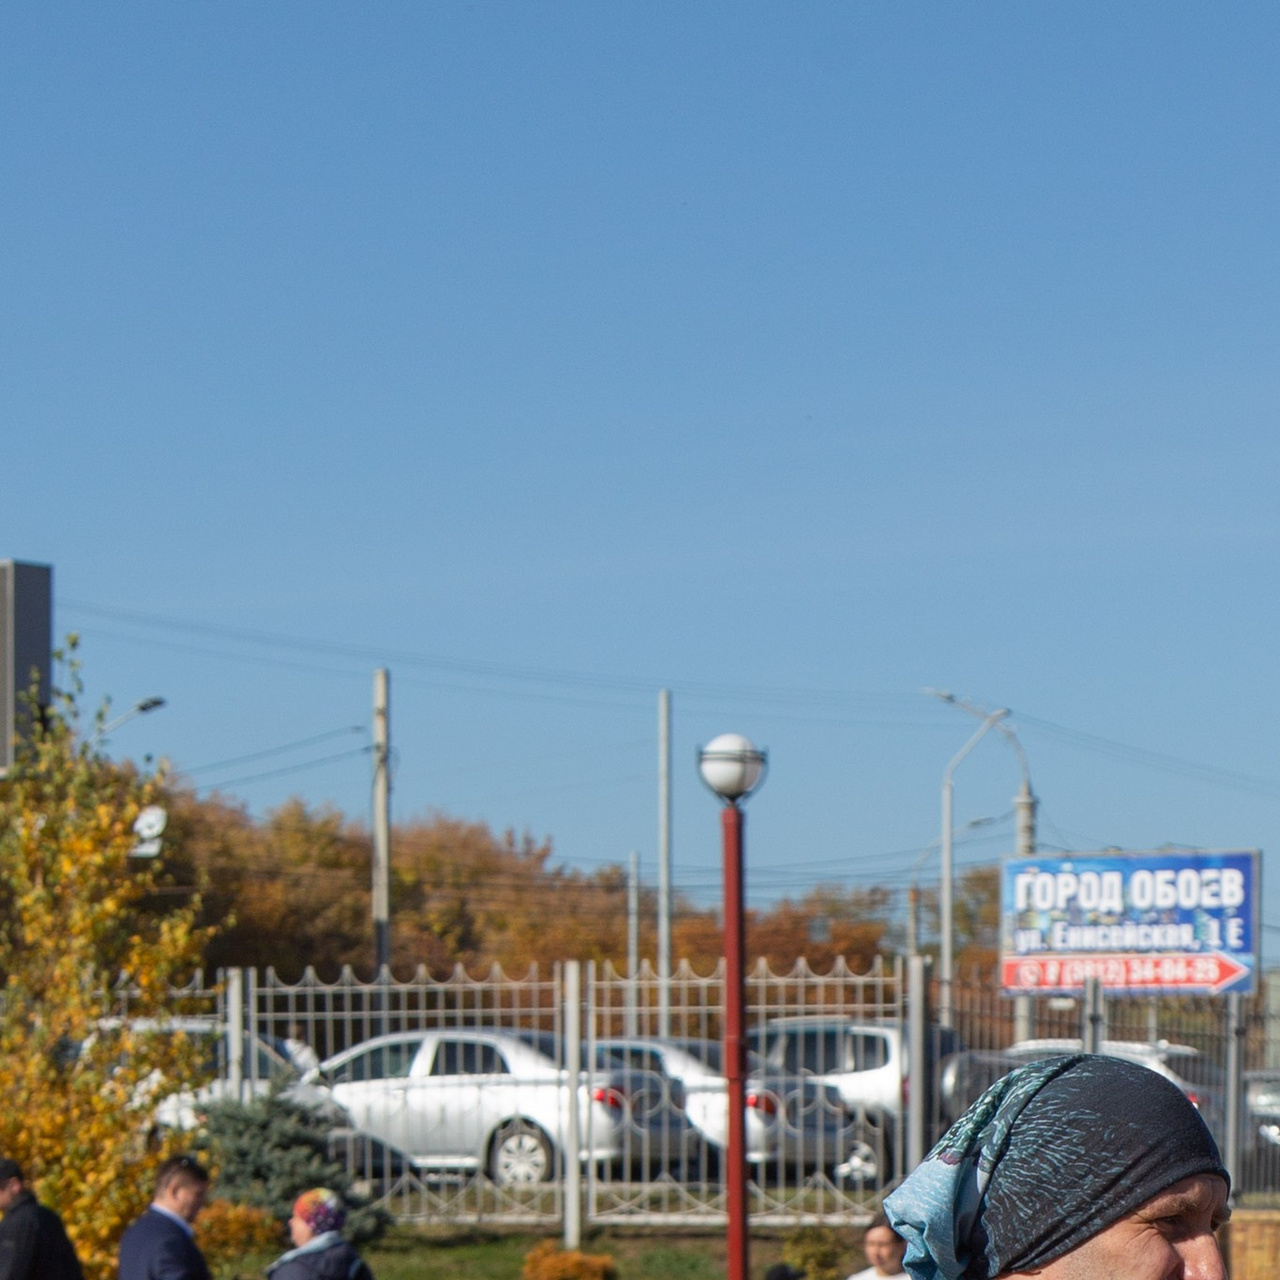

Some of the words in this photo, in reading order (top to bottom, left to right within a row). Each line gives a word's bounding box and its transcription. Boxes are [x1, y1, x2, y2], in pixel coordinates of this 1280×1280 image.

[1014, 871, 1124, 913] ГОРОД
[1129, 868, 1244, 910] ОБОЕВ
[1015, 929, 1047, 954] ул.
[1206, 918, 1222, 947] 1
[1226, 917, 1244, 948] Е
